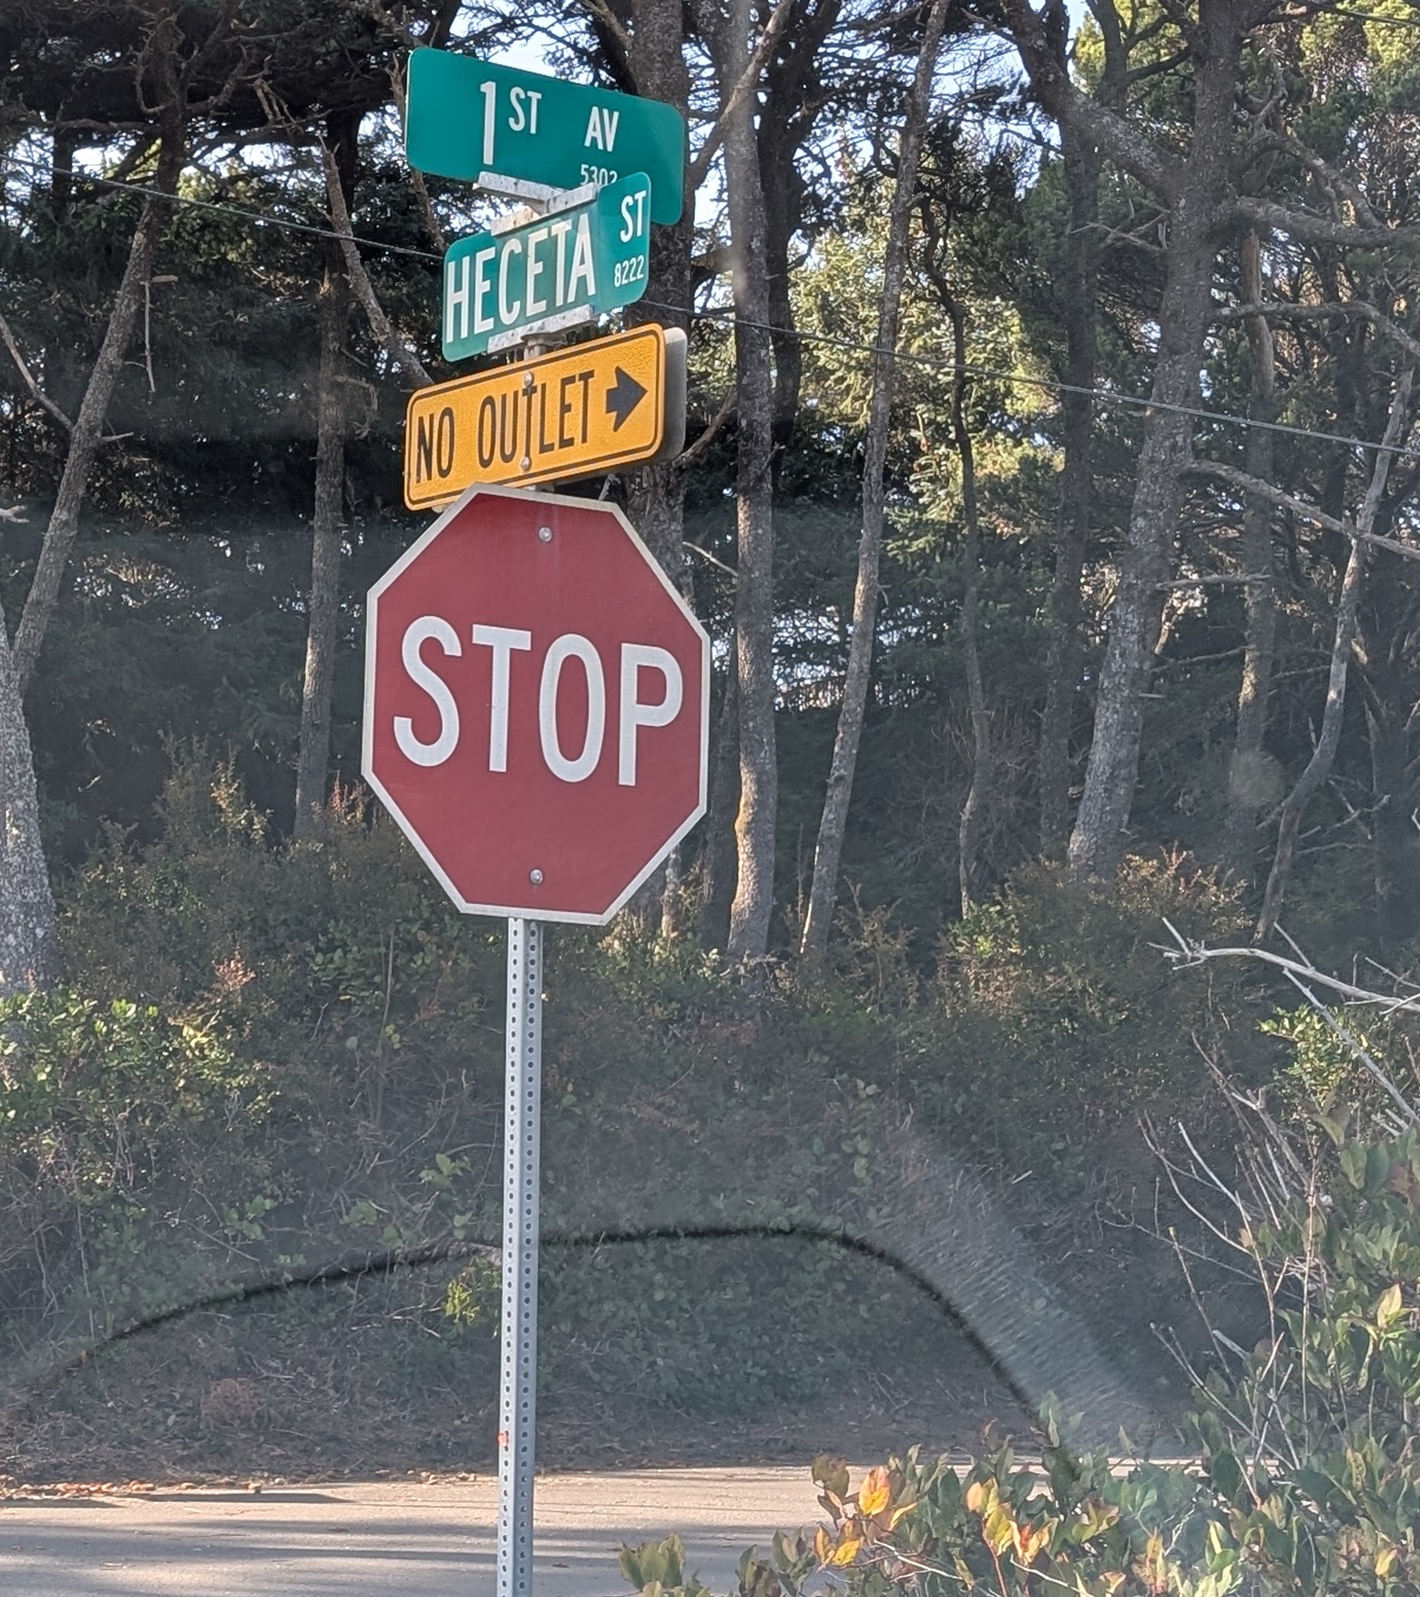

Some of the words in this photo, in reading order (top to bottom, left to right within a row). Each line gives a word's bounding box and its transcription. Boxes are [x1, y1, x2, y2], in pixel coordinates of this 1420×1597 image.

[584, 106, 620, 152] AV
[446, 213, 597, 343] HECETA
[620, 190, 647, 243] ST
[614, 255, 645, 287] 8222
[415, 406, 455, 484] NO
[477, 369, 596, 469] OUTLET
[393, 615, 683, 787] STOP
